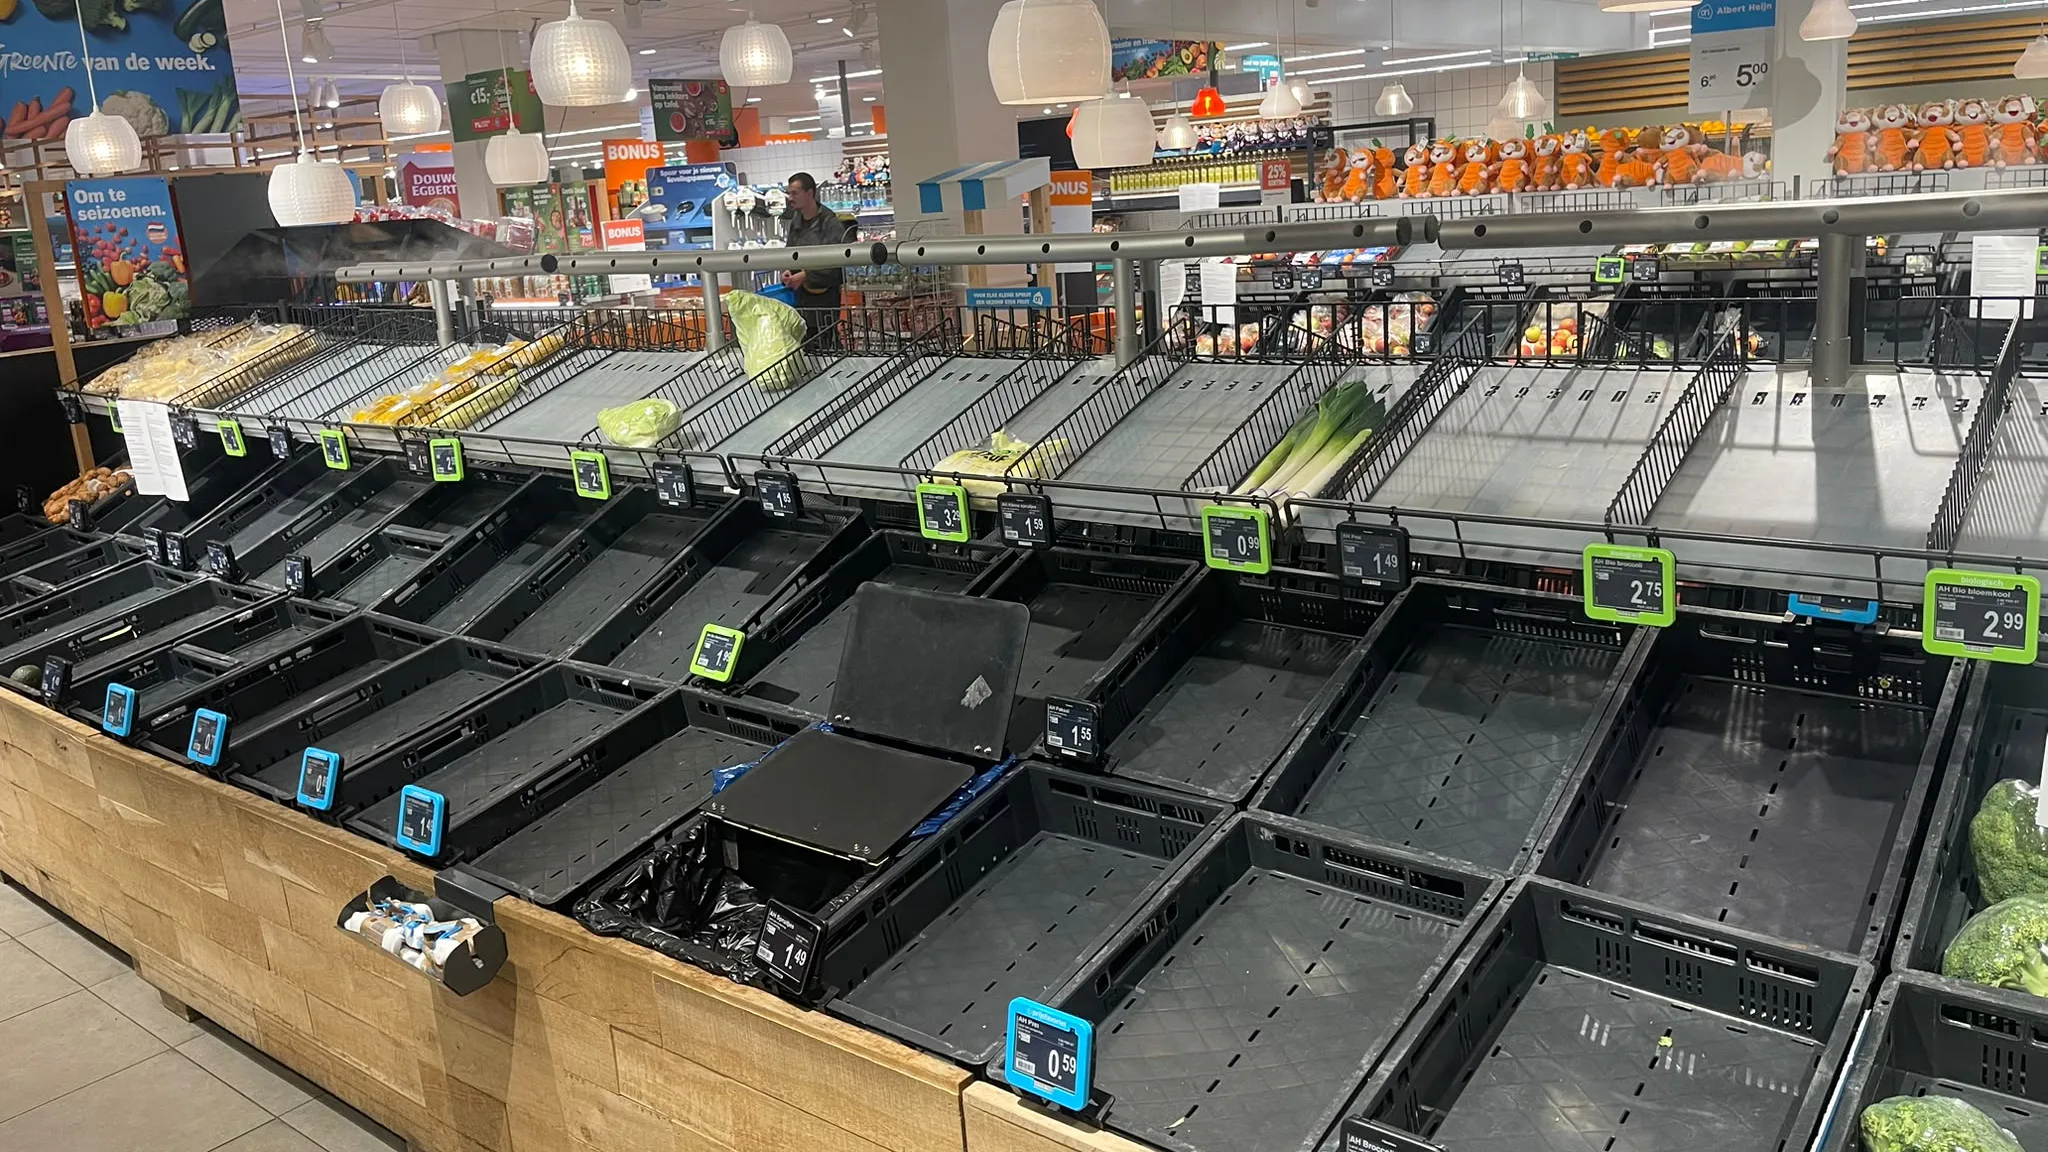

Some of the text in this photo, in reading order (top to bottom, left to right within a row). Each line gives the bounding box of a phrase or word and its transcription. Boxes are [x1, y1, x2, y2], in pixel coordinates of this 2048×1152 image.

[1717, 6, 1746, 15] Albert
[1748, 2, 1773, 12] Heijn
[81, 56, 120, 71] van
[125, 52, 150, 71] de
[155, 53, 216, 71] week.
[607, 143, 661, 161] BONUS
[1267, 164, 1287, 179] 25%
[74, 188, 127, 204] Om te
[78, 205, 167, 221] seizoenen.
[608, 226, 641, 239] BONUS
[1025, 516, 1044, 537] 1.59
[1237, 535, 1260, 556] 0.99
[1372, 552, 1399, 575] 1.49
[1960, 576, 2004, 587] biologisch
[1630, 579, 1663, 605] 2.75
[1938, 585, 1951, 593] AH
[1952, 586, 1967, 594] Bio
[1967, 588, 2011, 598] bloemkool
[1982, 610, 2025, 639] 2.99
[1071, 725, 1092, 747] 1.55
[784, 943, 808, 970] 1.49
[1018, 1016, 1040, 1029] AH Prei
[1048, 1049, 1077, 1081] 0.59
[1350, 1135, 1361, 1145] AH
